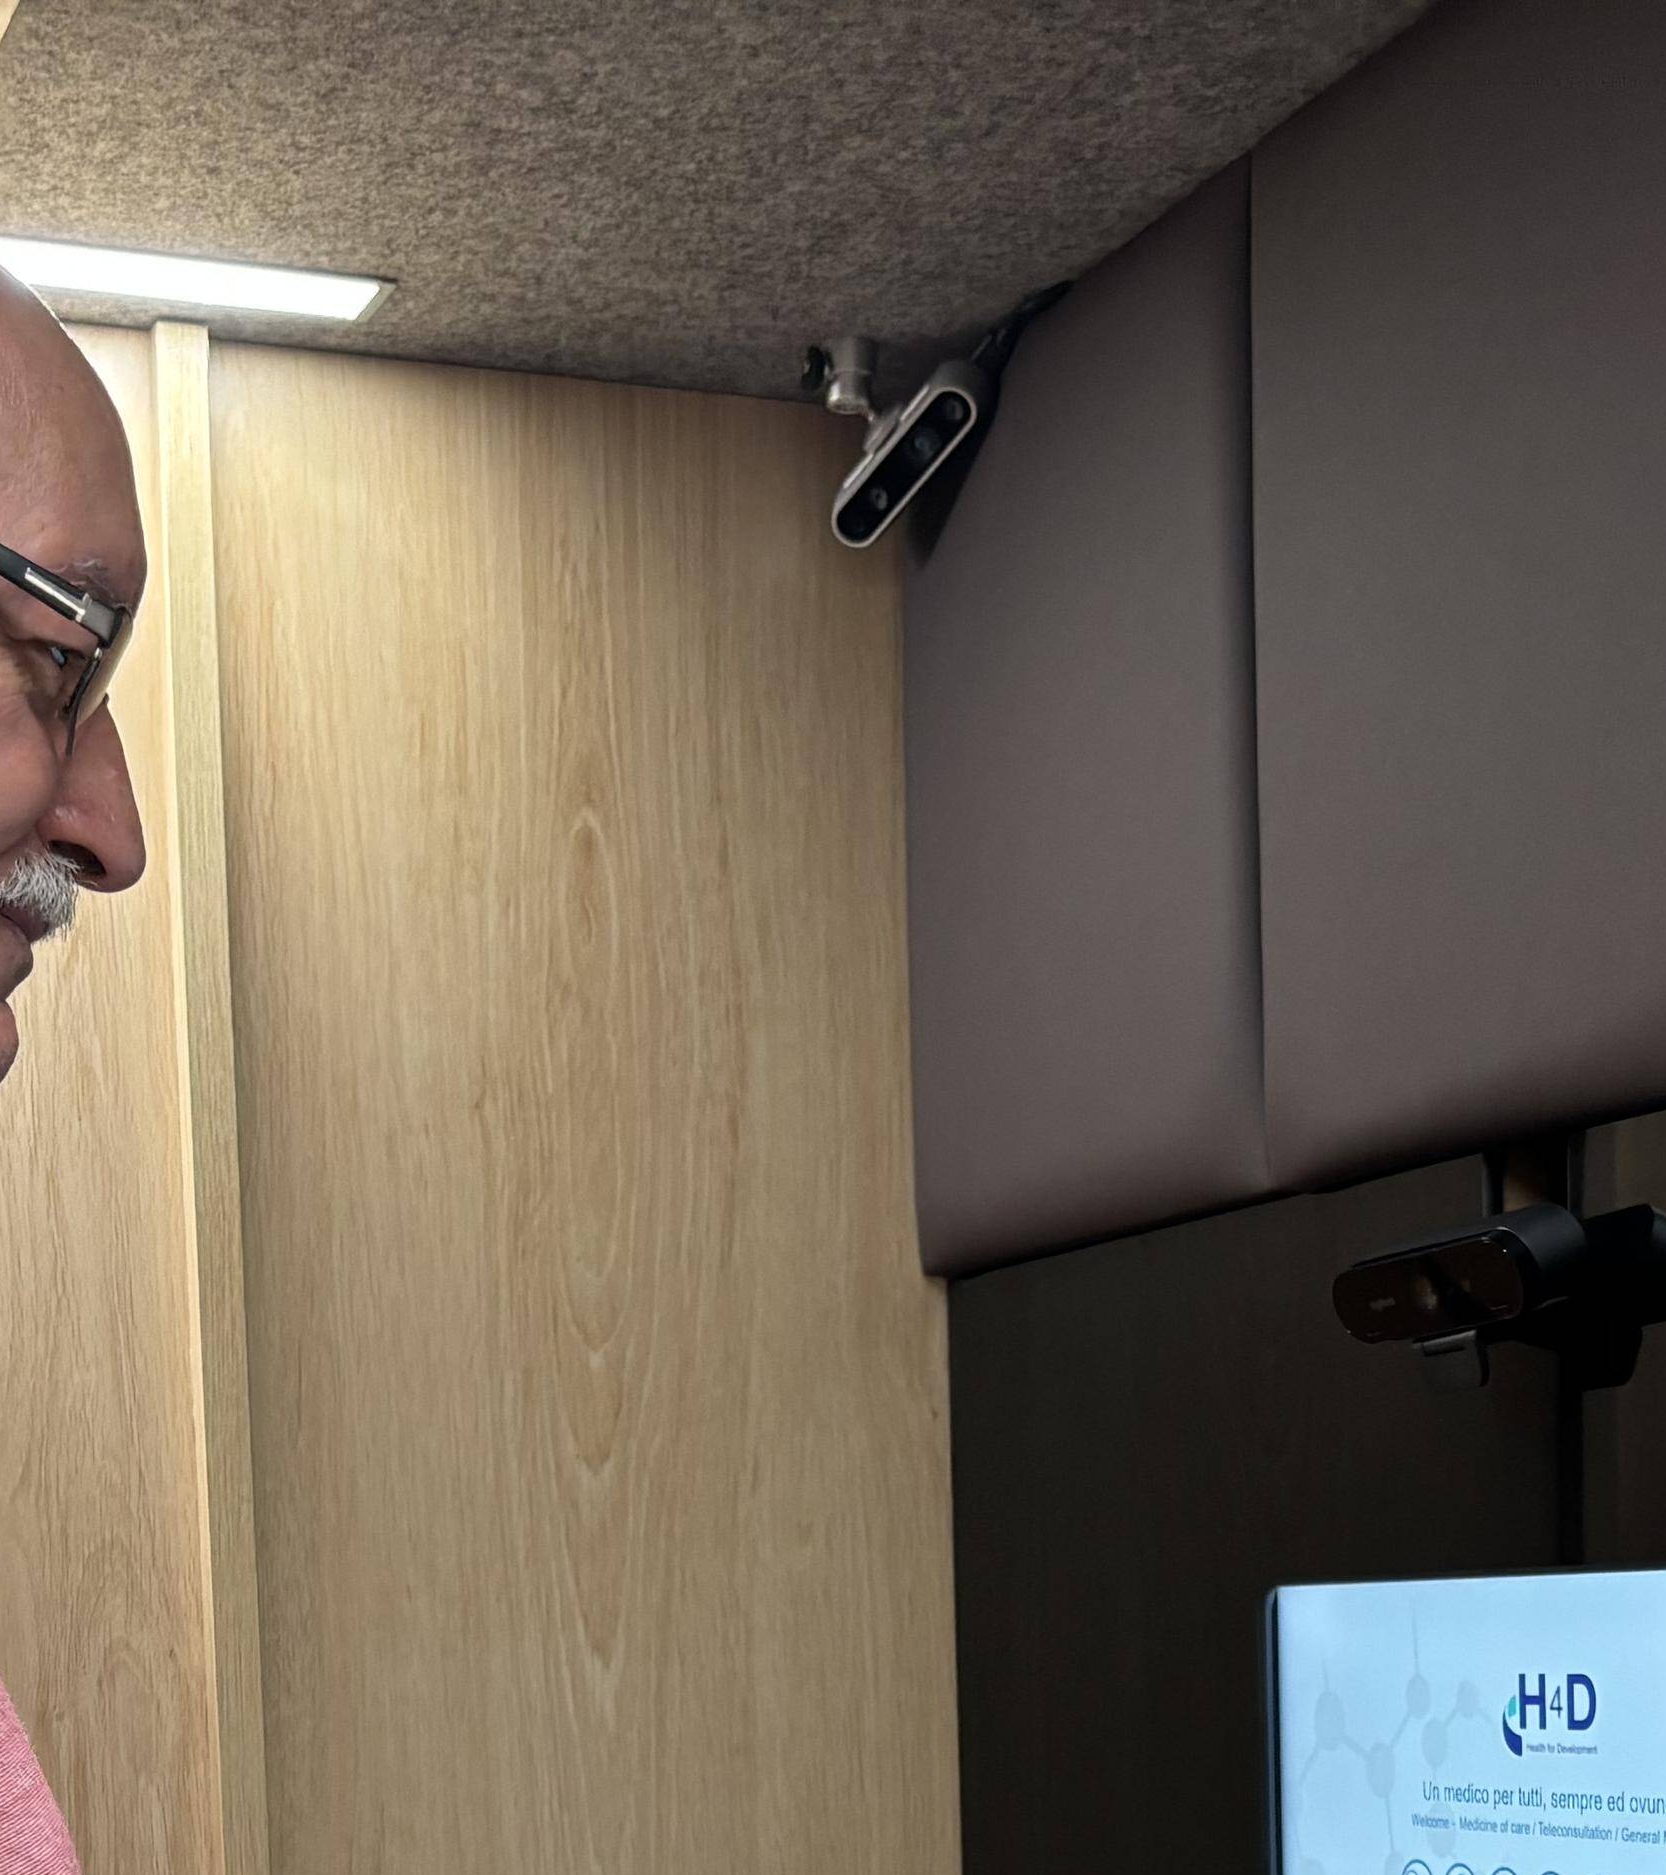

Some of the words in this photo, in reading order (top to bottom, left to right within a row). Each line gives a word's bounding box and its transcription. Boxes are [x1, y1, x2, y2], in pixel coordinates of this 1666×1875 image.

[1518, 1673, 1597, 1730] H4D
[1423, 1780, 1440, 1801] Un
[1444, 1783, 1490, 1804] medico
[1493, 1788, 1514, 1810] per
[1518, 1786, 1547, 1812] tutti,
[1551, 1792, 1602, 1815] sempre
[1607, 1791, 1625, 1813] ed
[1411, 1813, 1451, 1829] Welcome
[1459, 1816, 1498, 1833] Medicine
[1500, 1820, 1509, 1834] of
[1510, 1822, 1531, 1836] care
[1538, 1820, 1613, 1841] Teleconsultation
[1621, 1827, 1661, 1845] General
